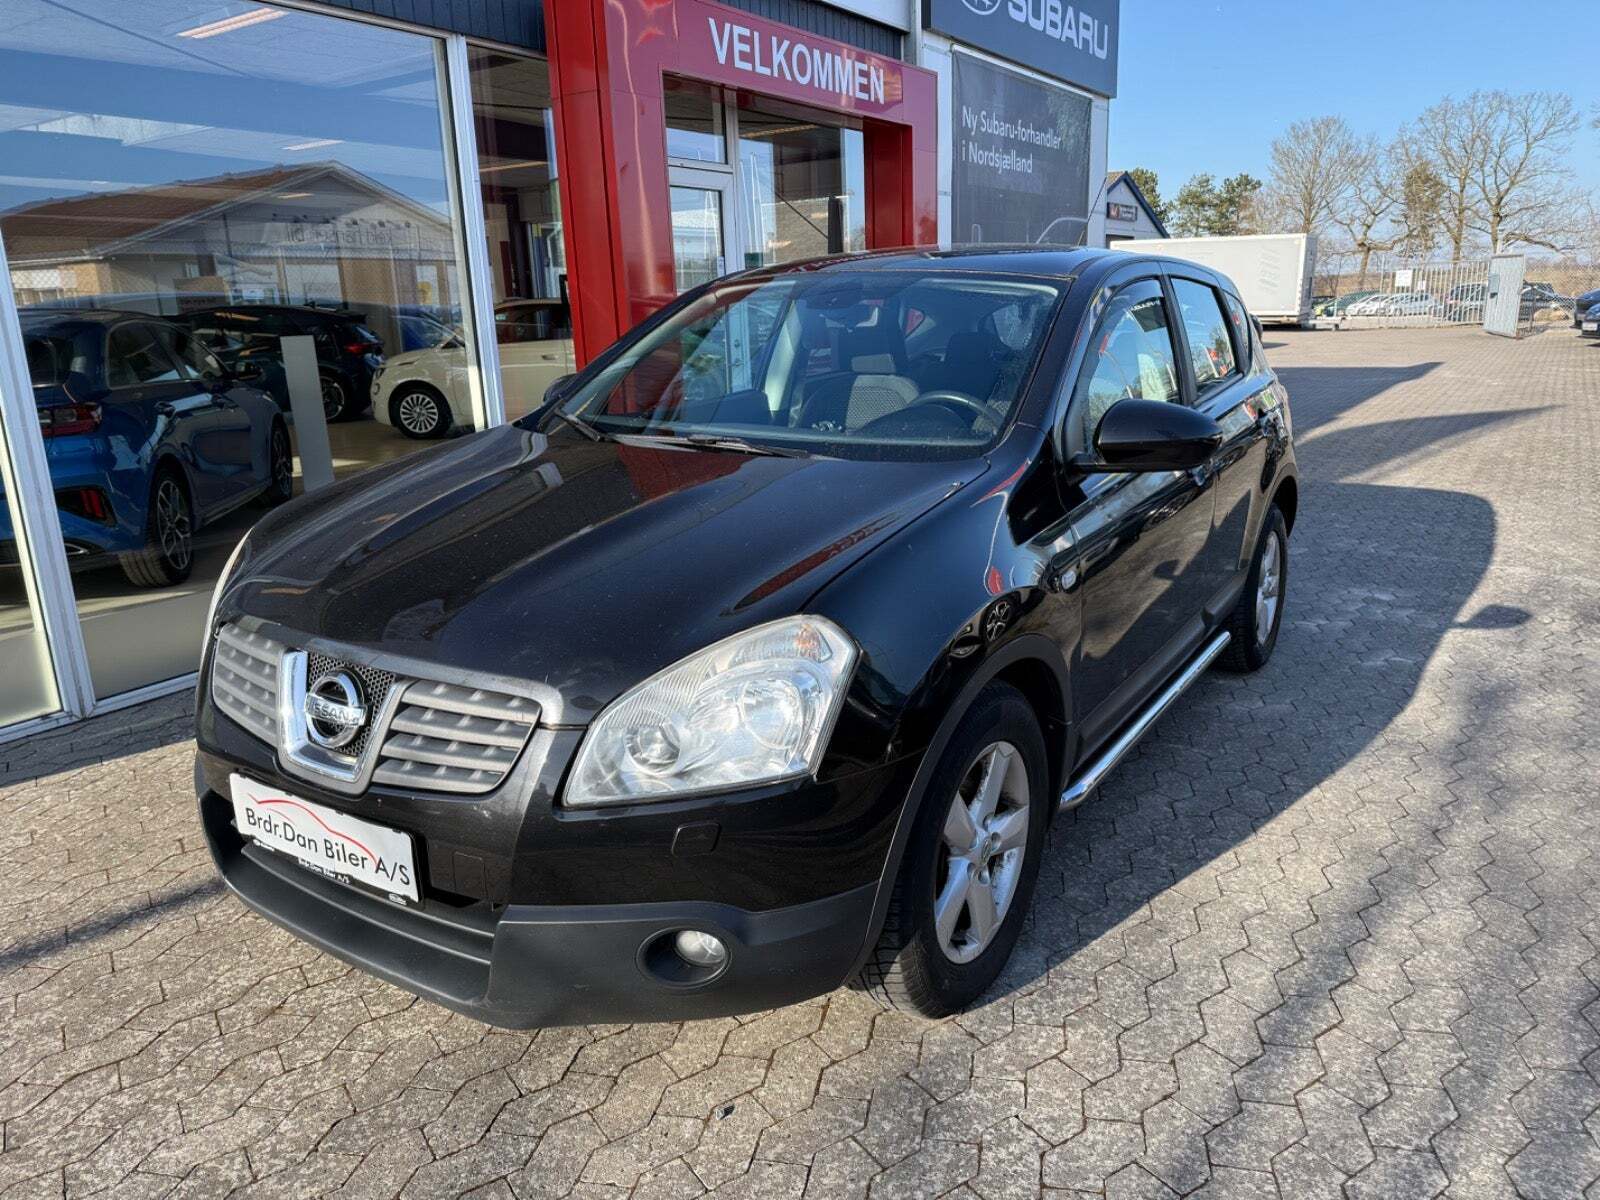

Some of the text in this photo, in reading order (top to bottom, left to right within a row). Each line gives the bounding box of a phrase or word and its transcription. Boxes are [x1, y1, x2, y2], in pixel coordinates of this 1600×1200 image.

[1007, 0, 1108, 60] SUBARU
[708, 16, 885, 105] VELKOMMEN
[961, 139, 1033, 174] i Nordsjælland
[962, 105, 1061, 149] Ny Subaru-forhandler
[245, 807, 318, 853] Brdr.Dan
[324, 838, 368, 869] Biler
[375, 856, 411, 886] A/S
